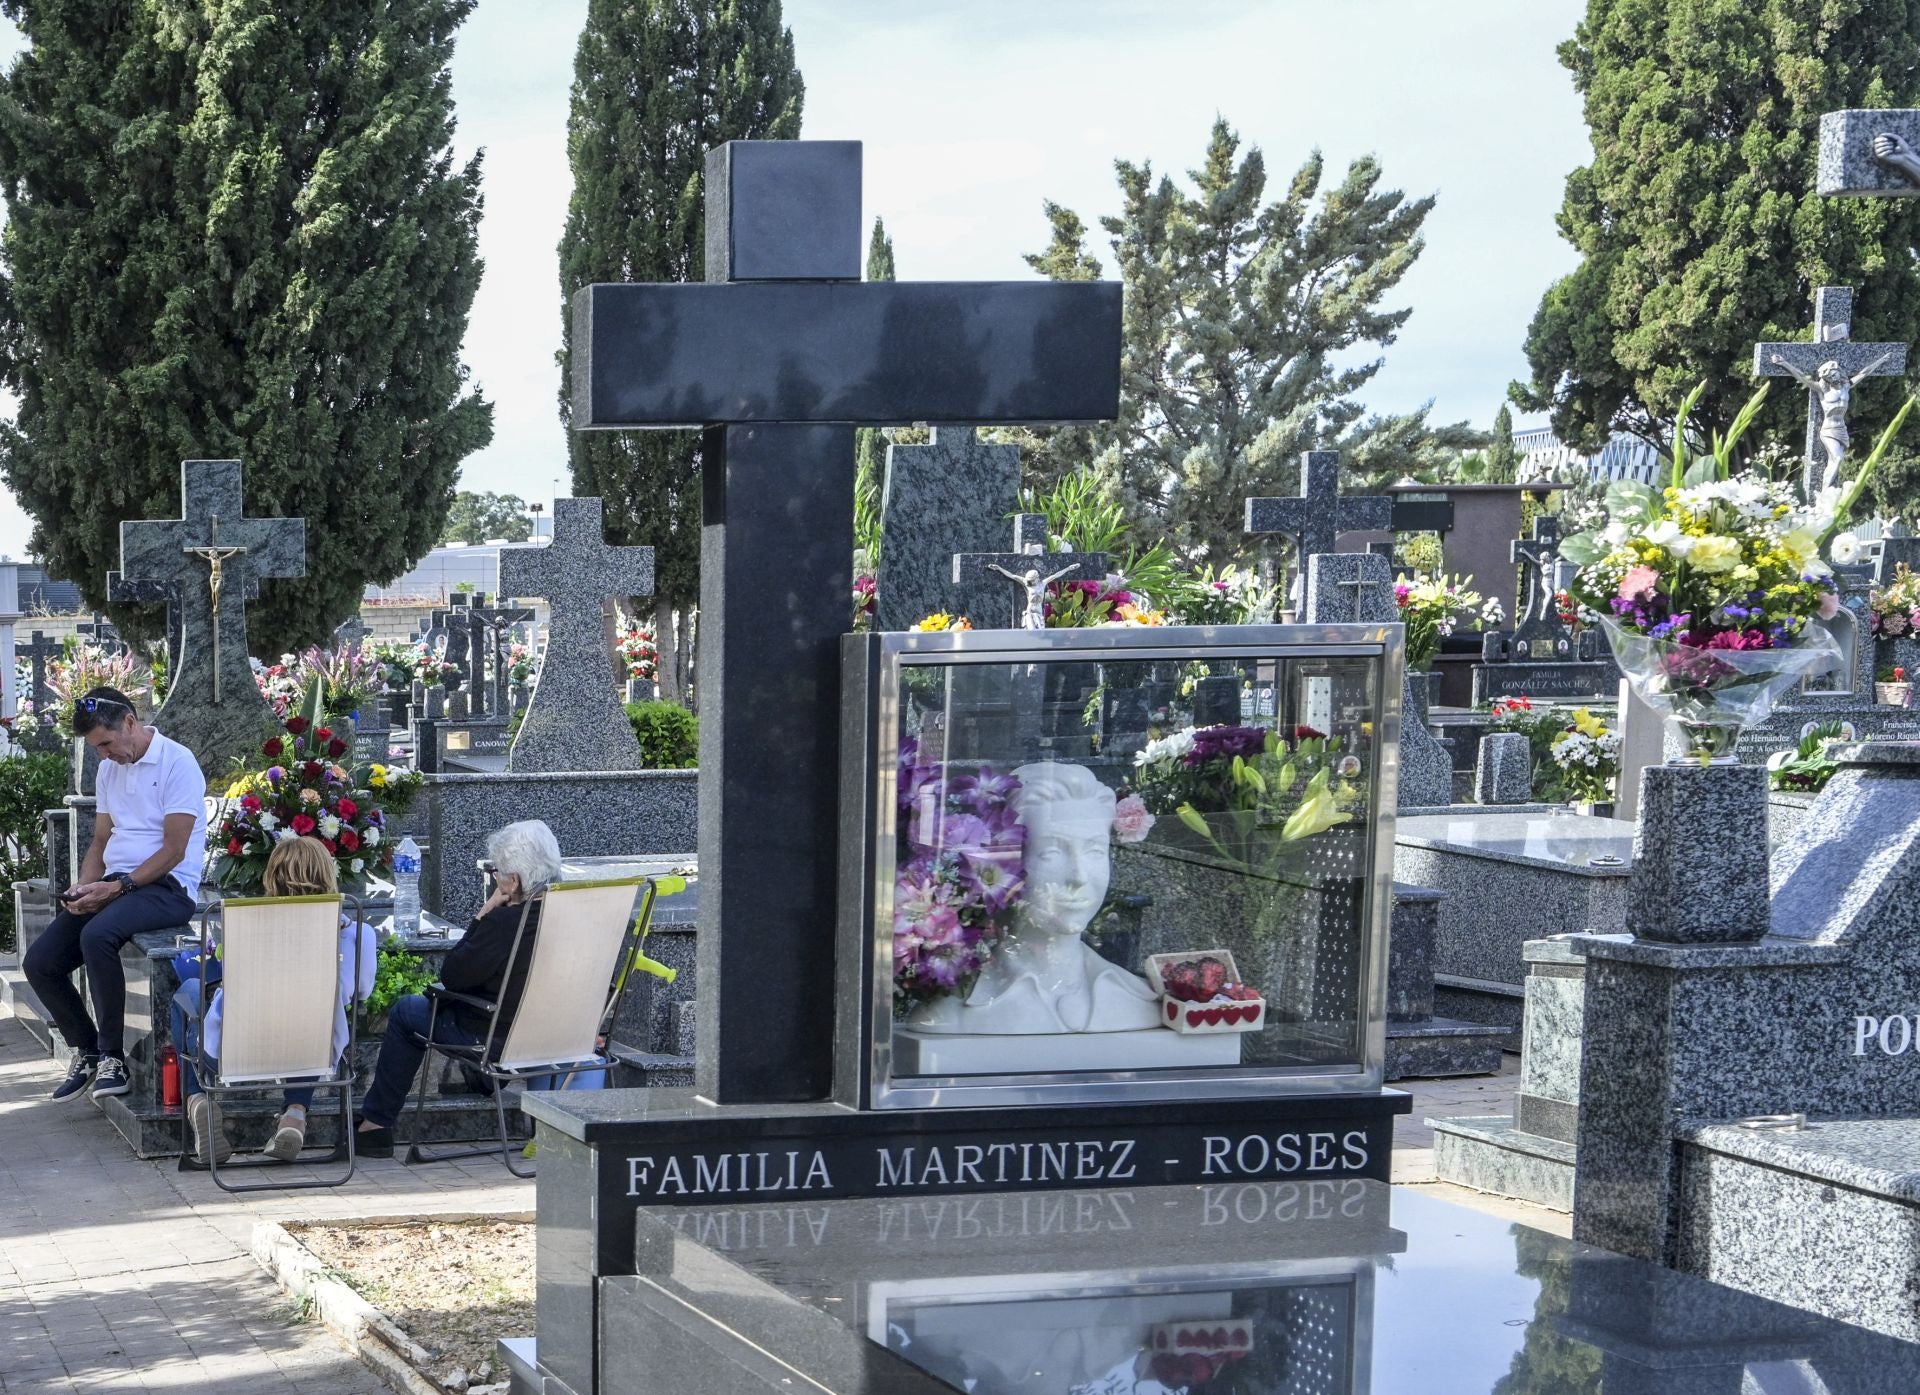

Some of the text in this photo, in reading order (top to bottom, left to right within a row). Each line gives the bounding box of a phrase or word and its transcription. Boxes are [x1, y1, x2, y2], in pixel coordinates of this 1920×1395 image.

[1851, 1014, 1920, 1055] PO
[626, 1151, 834, 1196] FAMILIA
[876, 1140, 1137, 1187] MARTINEZ
[1202, 1131, 1369, 1175] ROSES
